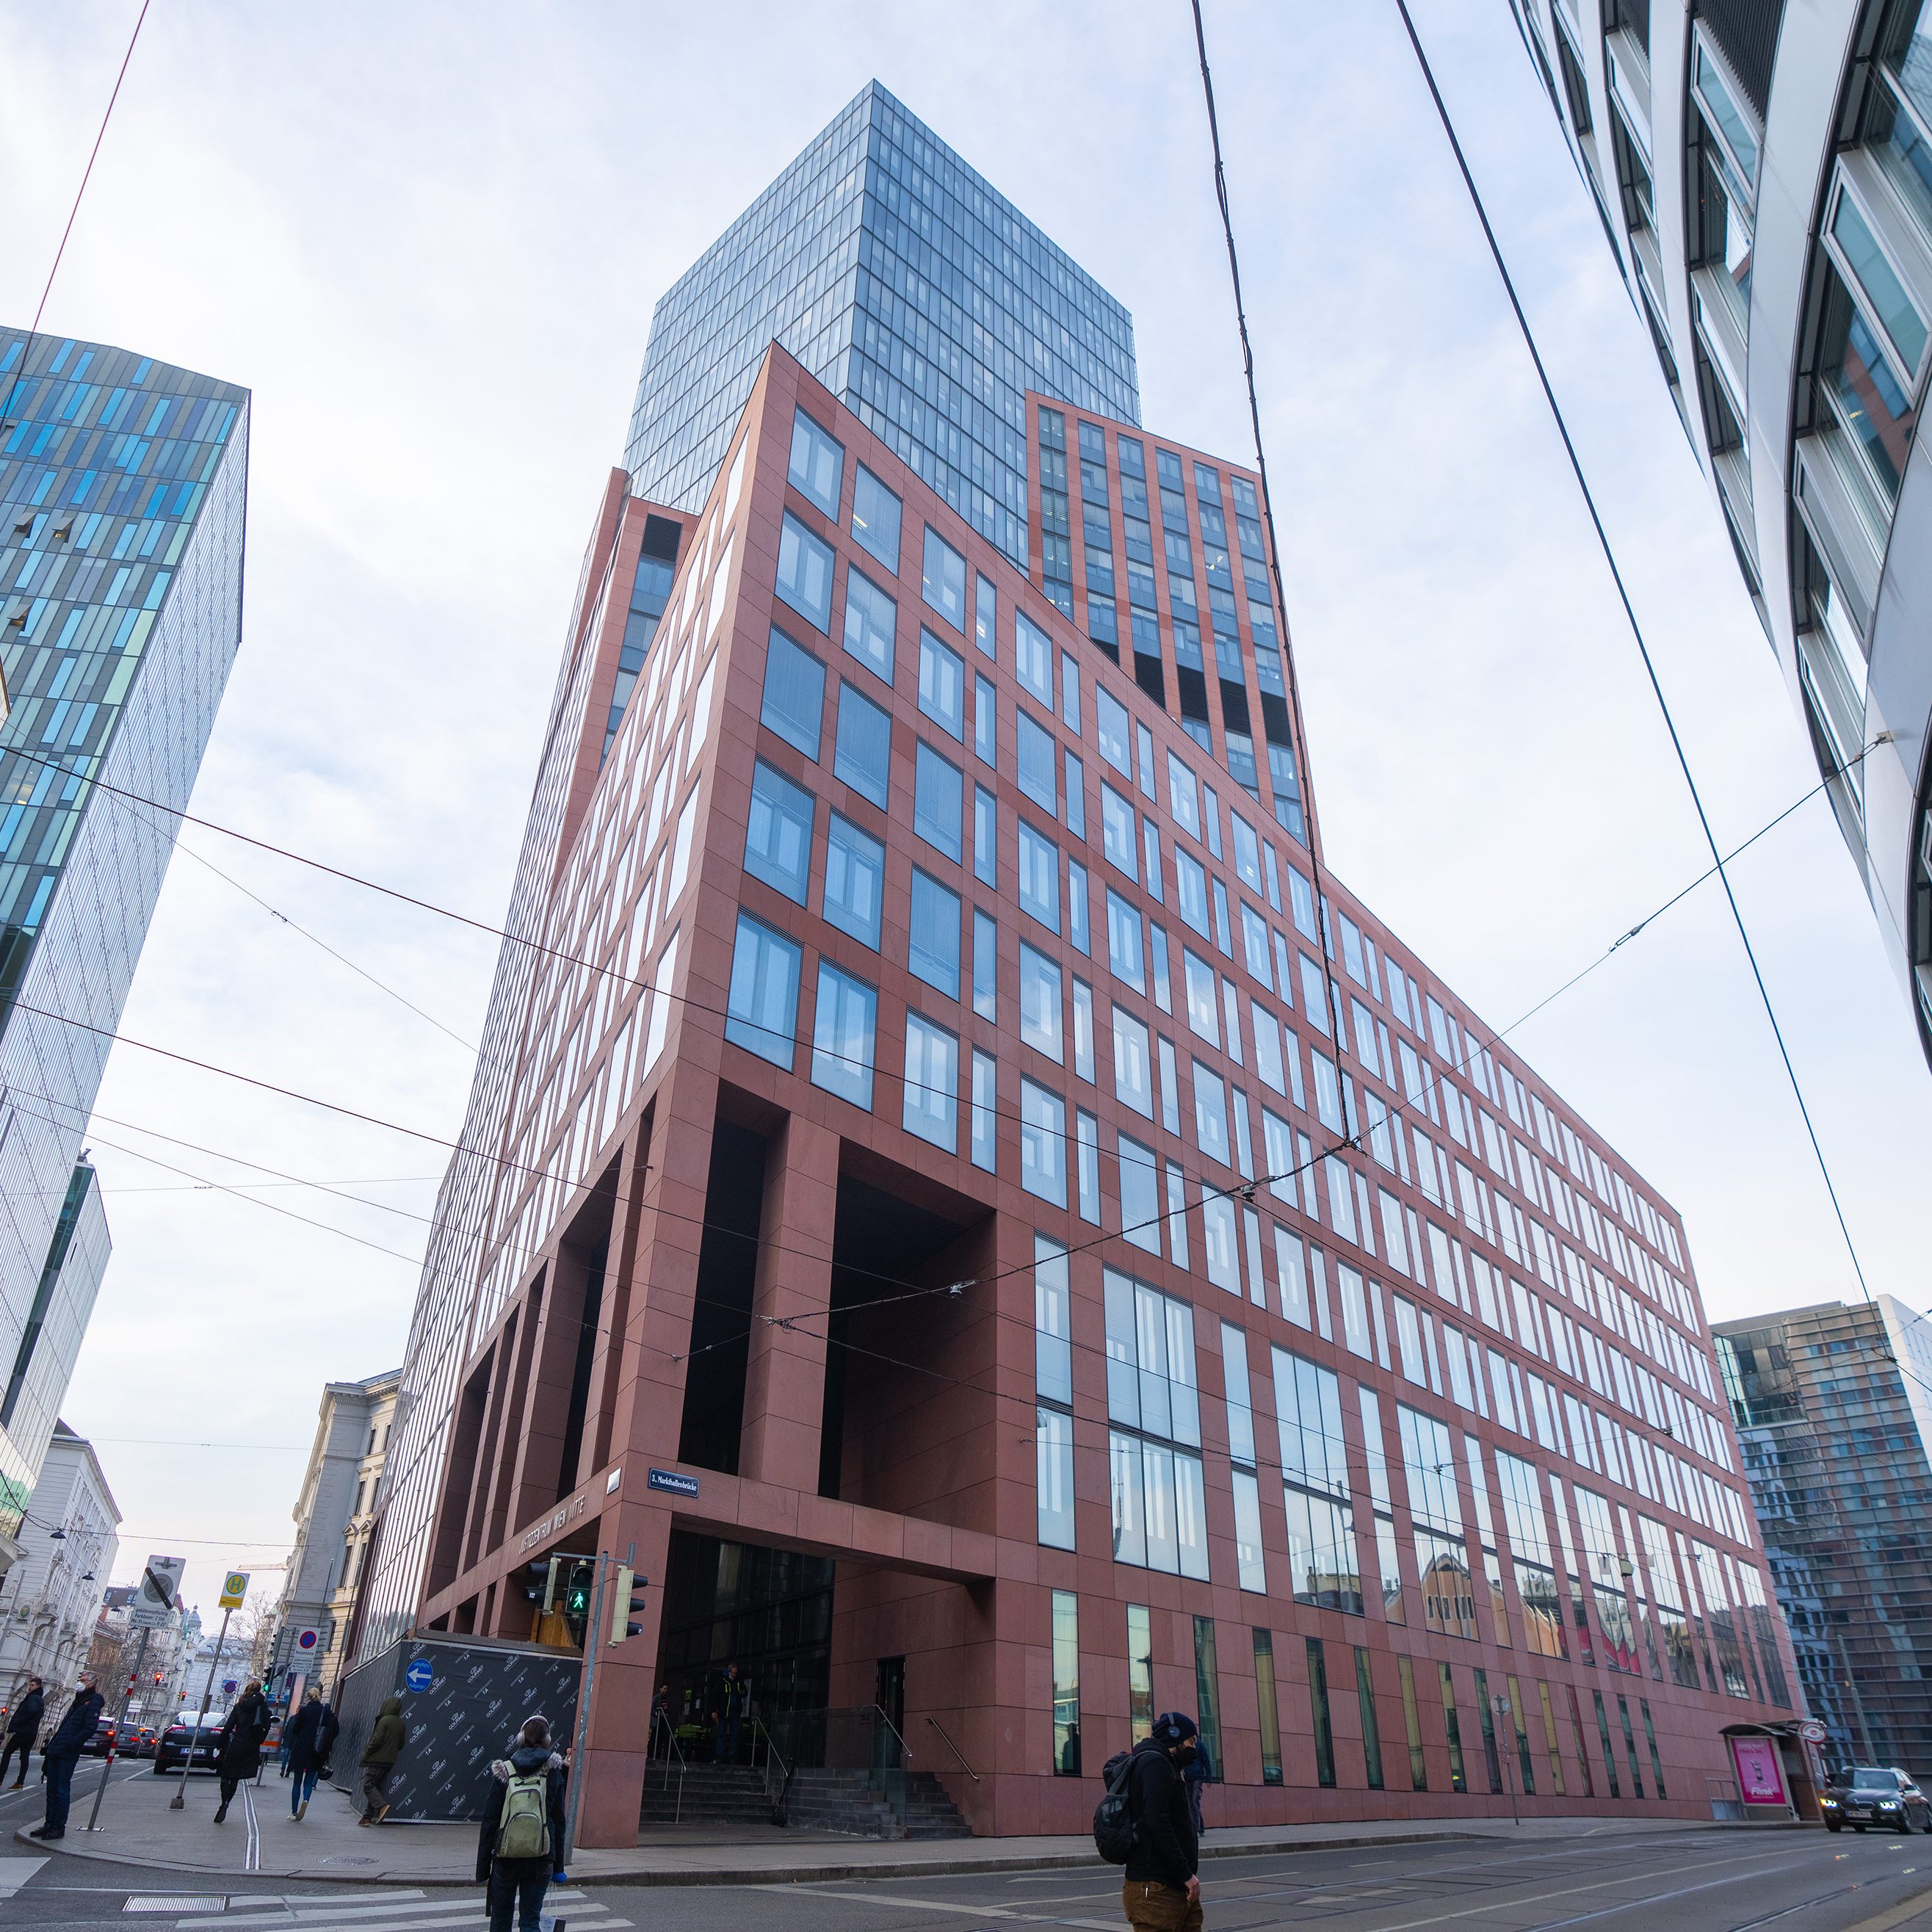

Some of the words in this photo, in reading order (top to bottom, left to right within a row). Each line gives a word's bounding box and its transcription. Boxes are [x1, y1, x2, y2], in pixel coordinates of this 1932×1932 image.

[658, 1476, 697, 1491] Markthallenbrücke
[554, 1508, 567, 1530] WIEN
[231, 1578, 242, 1591] H
[504, 1655, 520, 1671] GOURMET
[468, 1665, 484, 1683] GOURMET
[430, 1676, 446, 1695] GOURMET
[557, 1676, 571, 1693] GOURMET
[522, 1687, 538, 1705] GOURMET
[486, 1699, 502, 1718] GOURMET
[449, 1711, 466, 1730] GOURMET
[410, 1723, 427, 1743] GOURMET
[468, 1745, 485, 1765] GOURMET
[429, 1759, 446, 1779] GOURMET
[389, 1773, 407, 1794] GOURMET
[1751, 1786, 1774, 1795] Flink
[405, 1798, 412, 1806] 1A
[449, 1794, 466, 1815] GOURMET
